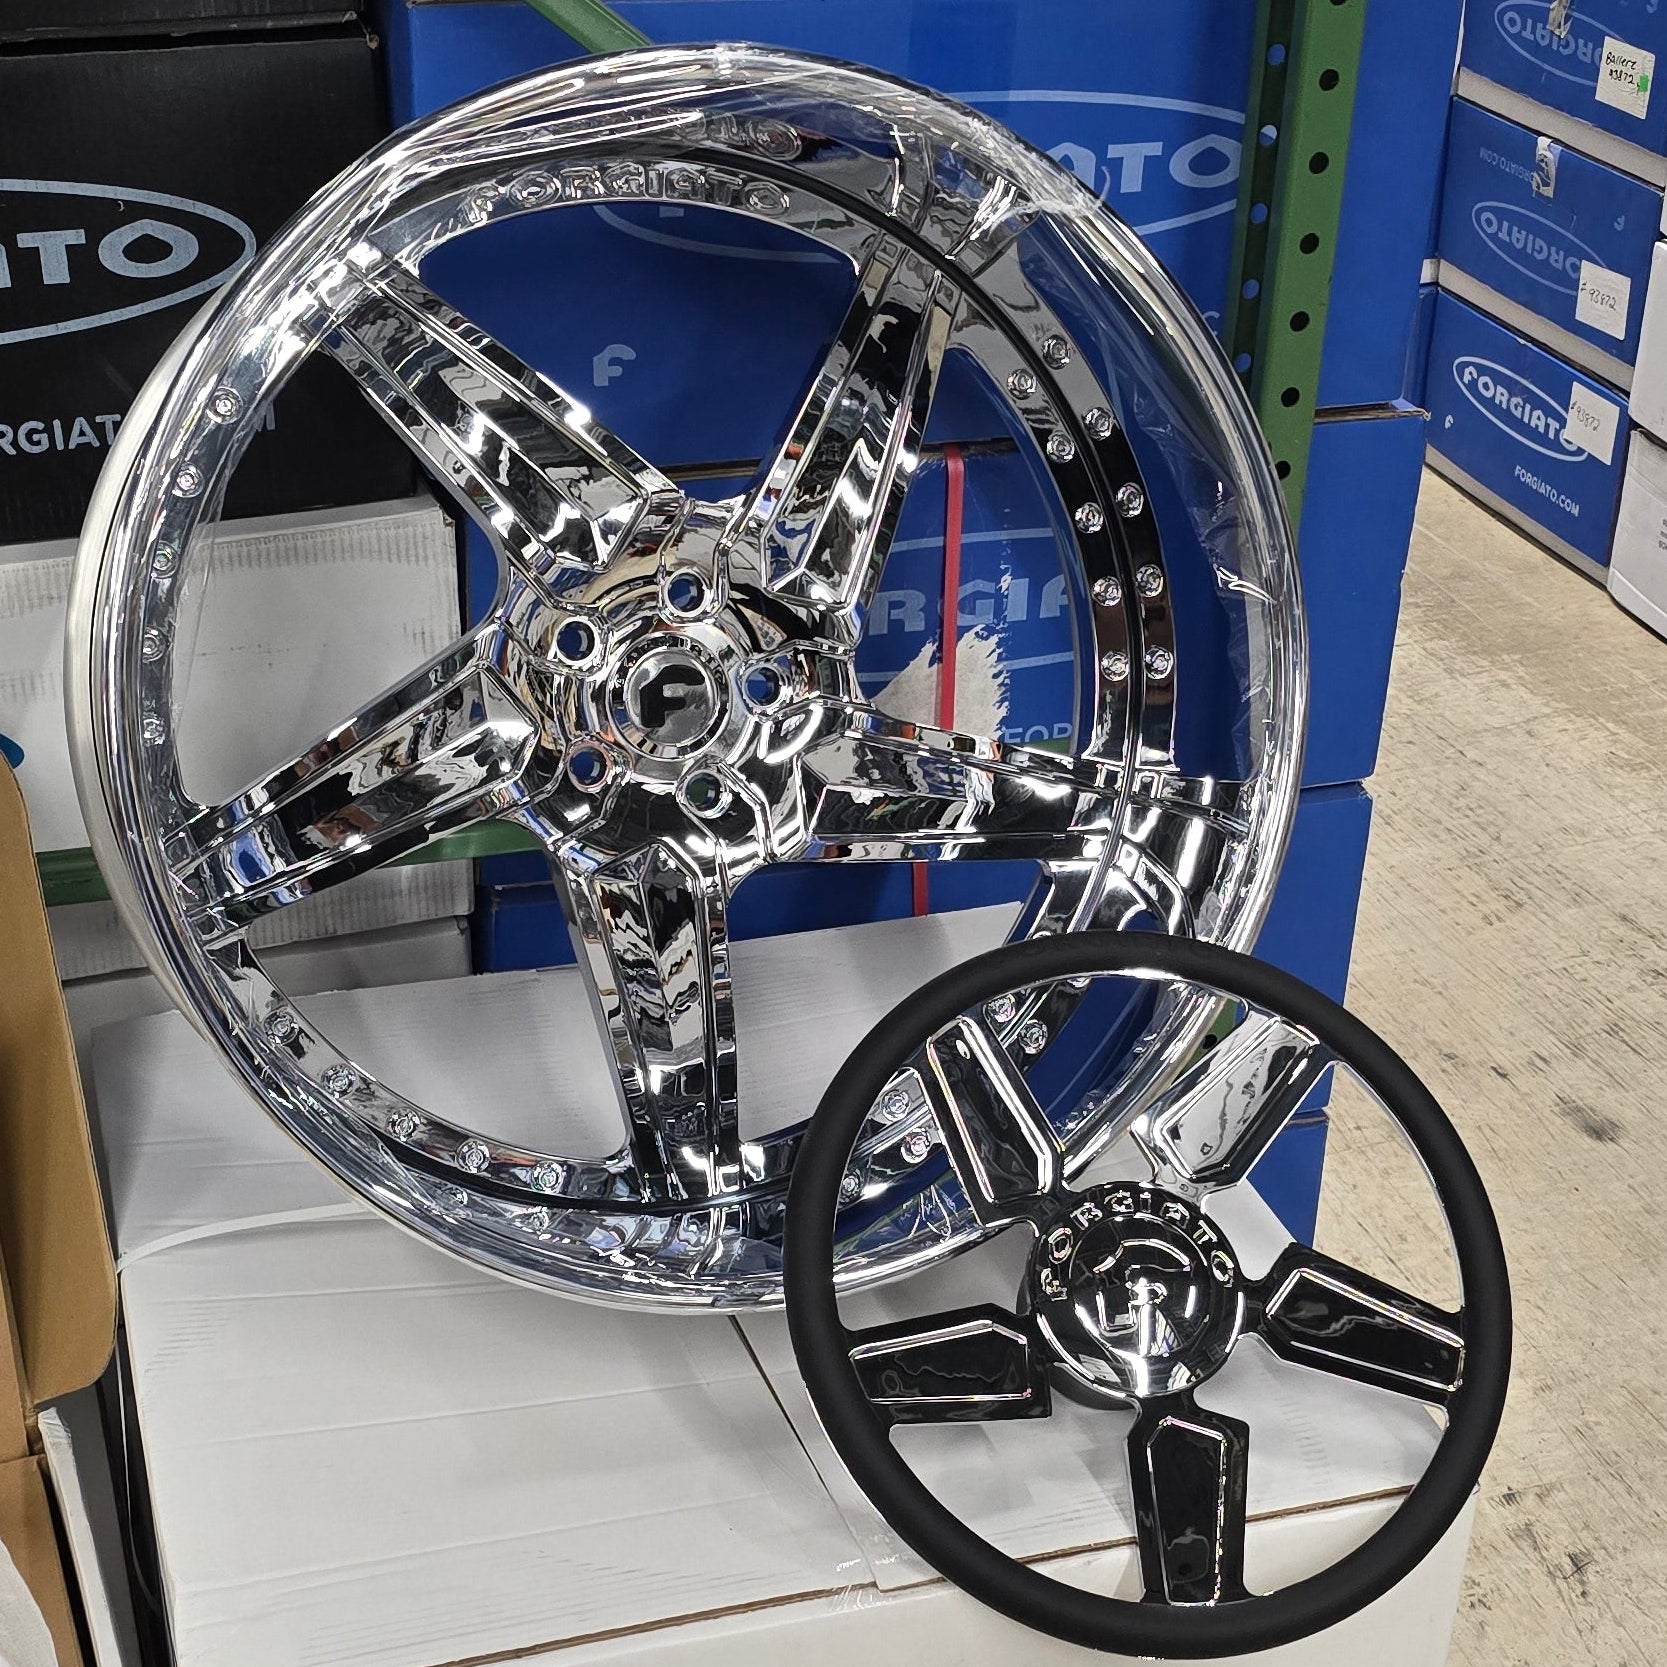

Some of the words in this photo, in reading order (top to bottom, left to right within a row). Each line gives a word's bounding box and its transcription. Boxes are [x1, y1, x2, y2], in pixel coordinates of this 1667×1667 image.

[466, 160, 790, 222] FORGIATO
[0, 218, 199, 288] TO
[592, 344, 636, 387] F
[1445, 414, 1453, 429] F
[1514, 465, 1580, 517] FORGIATO.COM
[639, 663, 706, 728] F
[1040, 1190, 1235, 1302] FORGIATO
